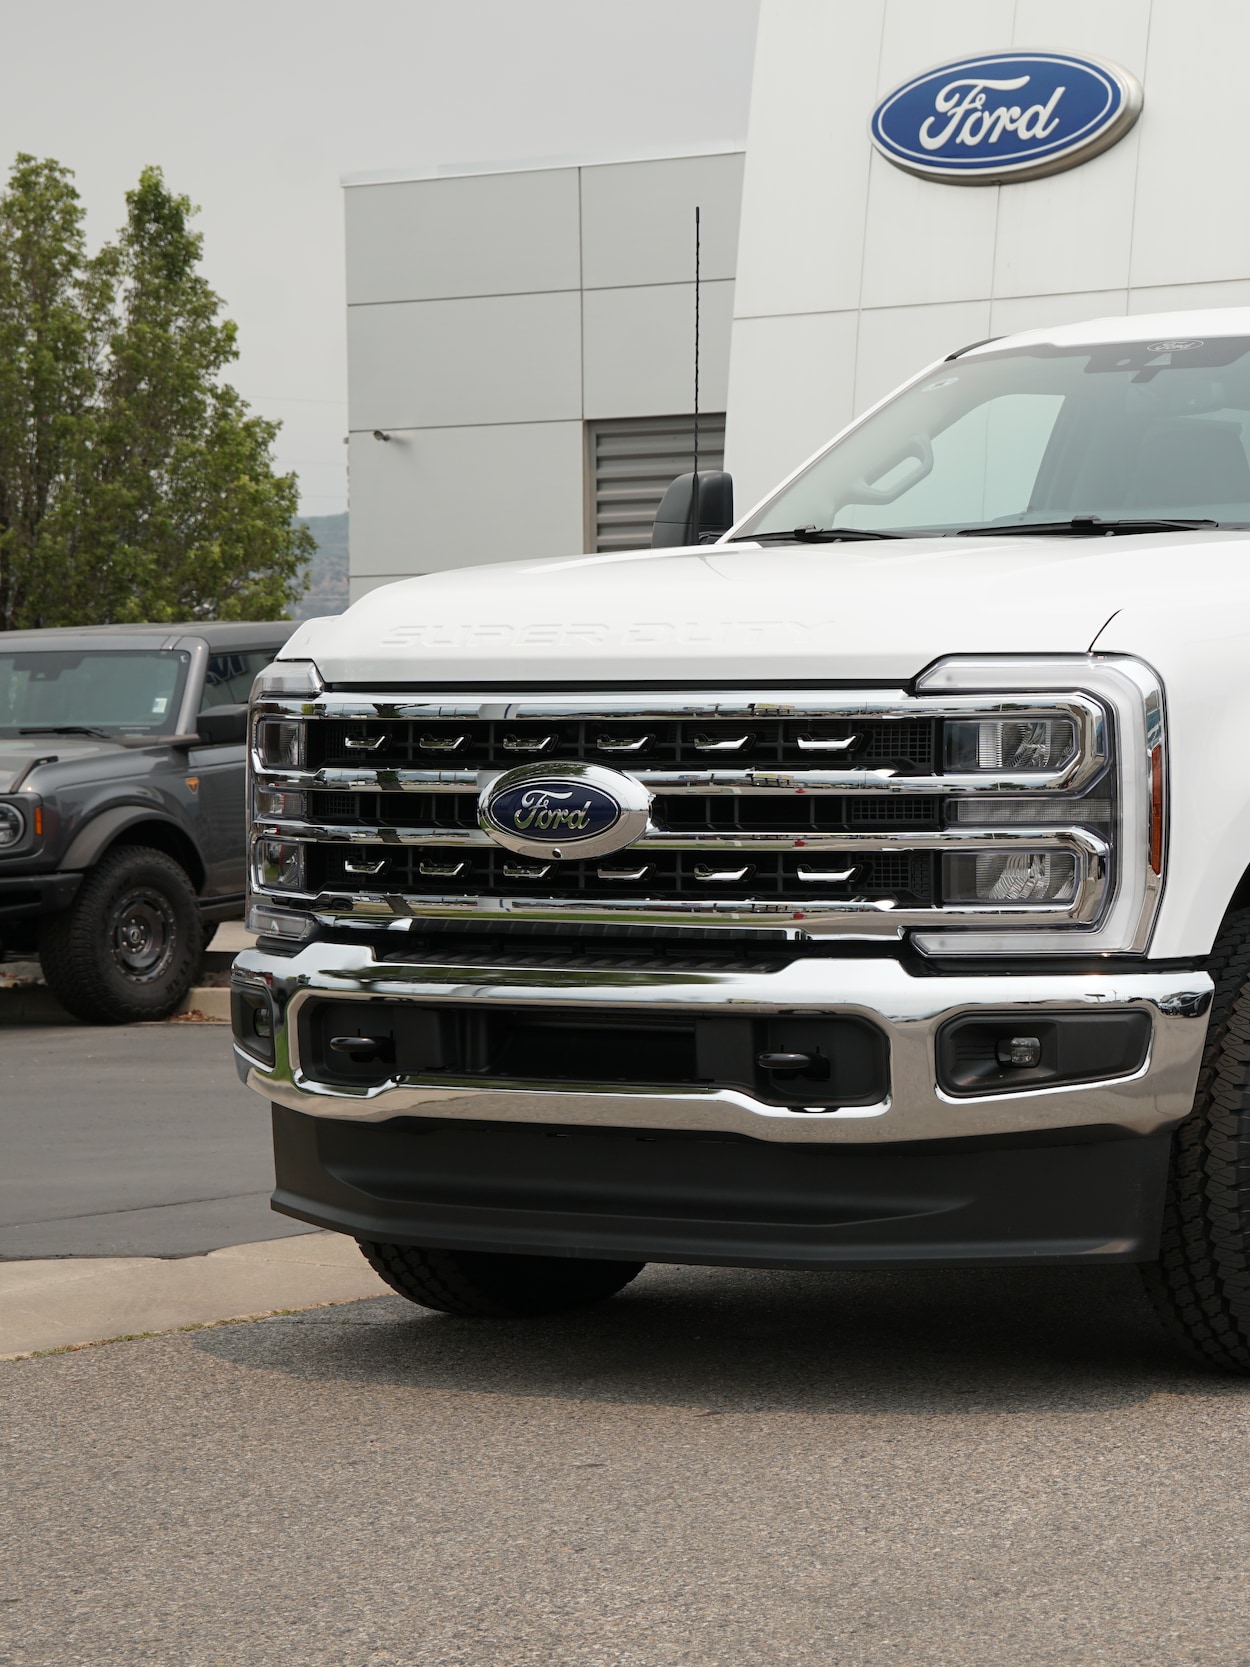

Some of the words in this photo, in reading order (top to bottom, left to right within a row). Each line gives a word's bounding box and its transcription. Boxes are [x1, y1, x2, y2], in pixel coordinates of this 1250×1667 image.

[919, 75, 1066, 150] Ford
[379, 622, 611, 648] SUPER
[621, 619, 836, 646] DUTY
[514, 789, 592, 830] Ford
